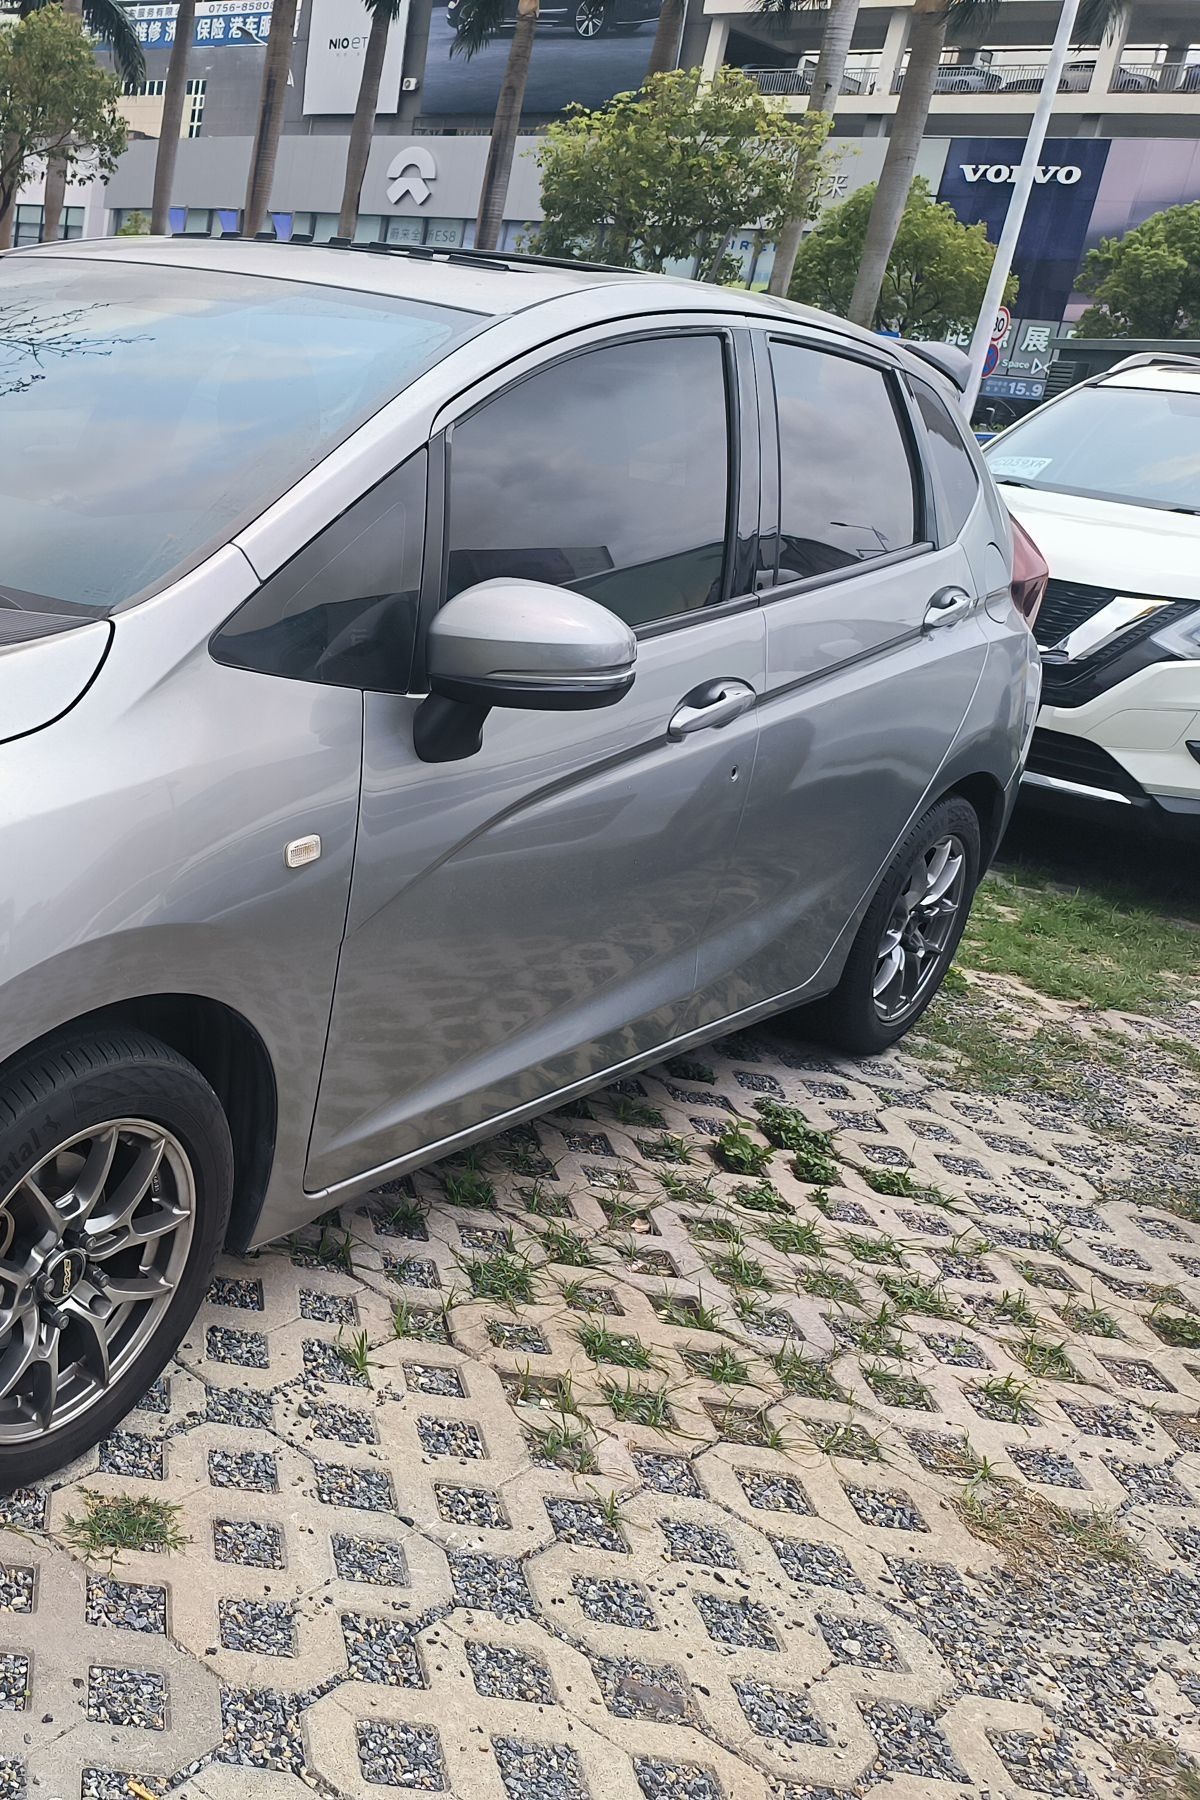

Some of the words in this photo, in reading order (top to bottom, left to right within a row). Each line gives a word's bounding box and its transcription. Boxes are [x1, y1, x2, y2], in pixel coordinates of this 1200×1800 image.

[197, 17, 225, 40] 保险
[328, 38, 350, 50] NIO
[1001, 358, 1030, 370] Space
[1008, 382, 1043, 397] 15.9
